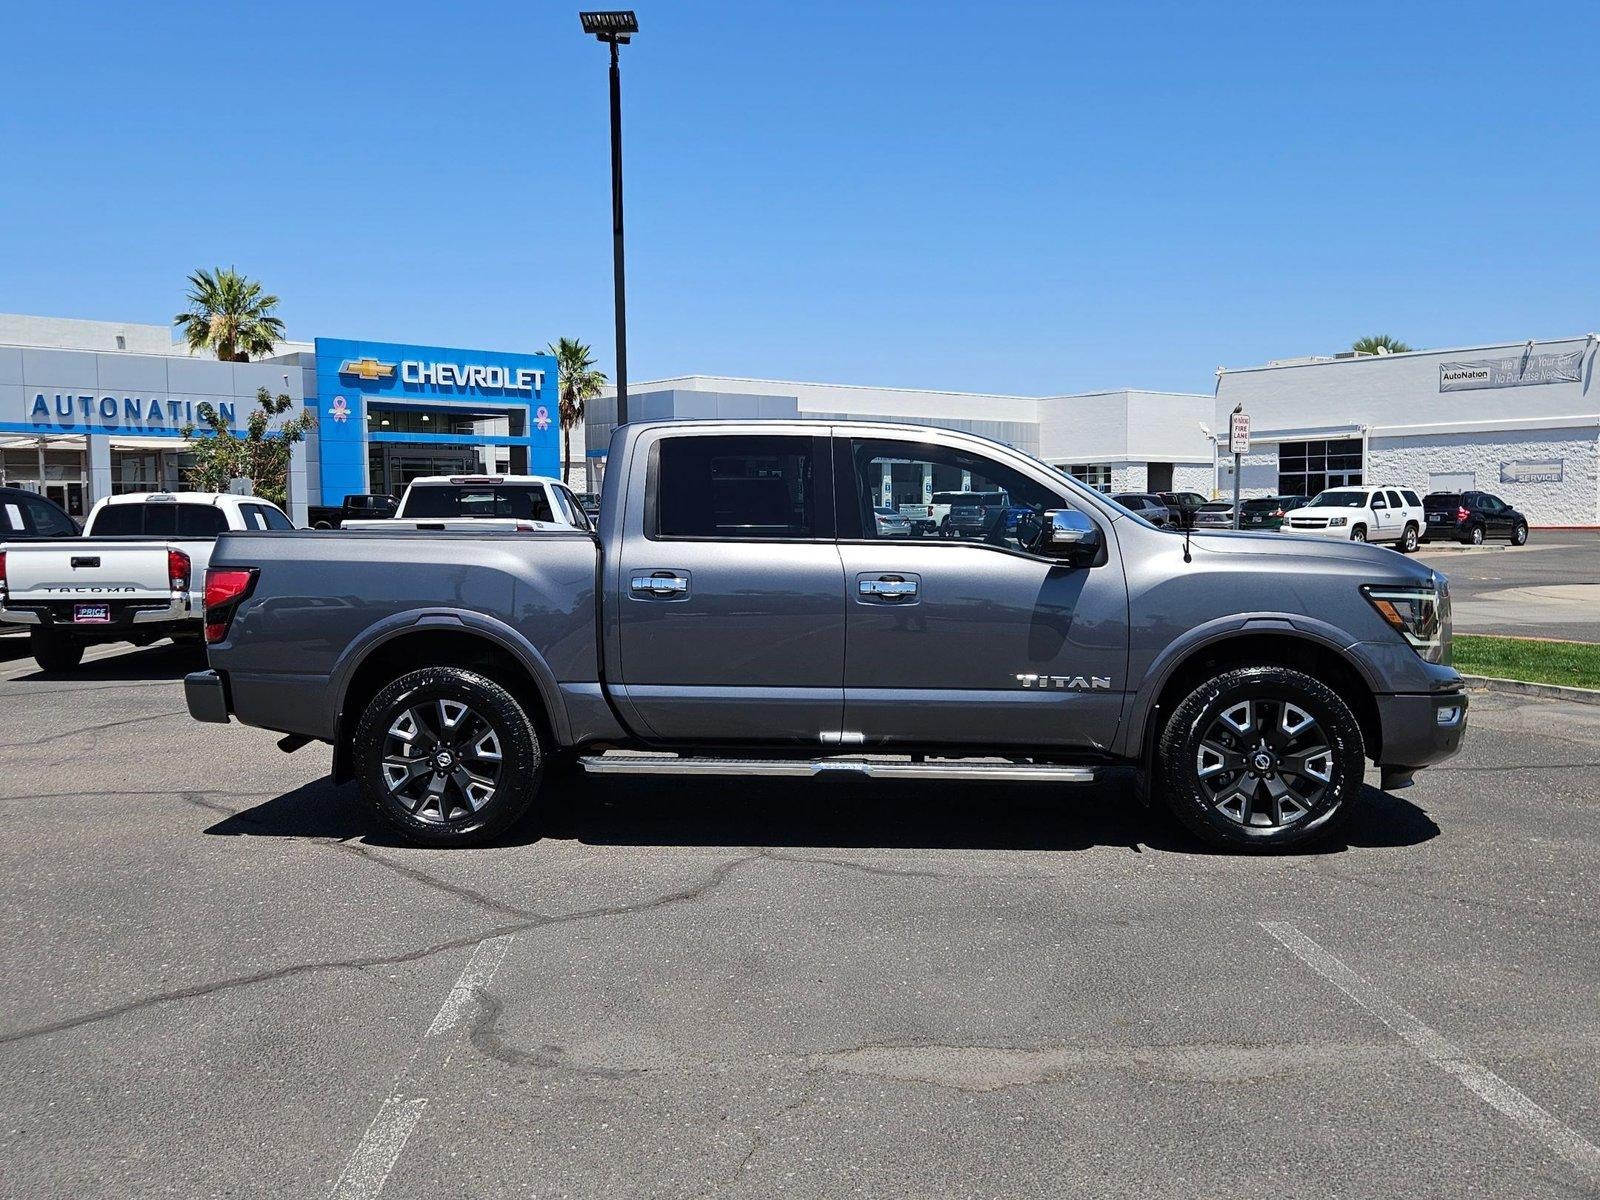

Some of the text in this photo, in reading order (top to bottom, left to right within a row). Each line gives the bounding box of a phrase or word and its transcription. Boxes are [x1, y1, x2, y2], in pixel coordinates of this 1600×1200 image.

[1537, 355, 1555, 368] Your
[401, 360, 546, 391] CHEVROLET
[1443, 370, 1488, 381] AutoNation
[1494, 373, 1505, 384] No
[1506, 370, 1540, 383] Purchase
[32, 394, 235, 422] AUTONATION
[1519, 474, 1557, 482] SERVICE
[1016, 674, 1111, 689] TITAN
